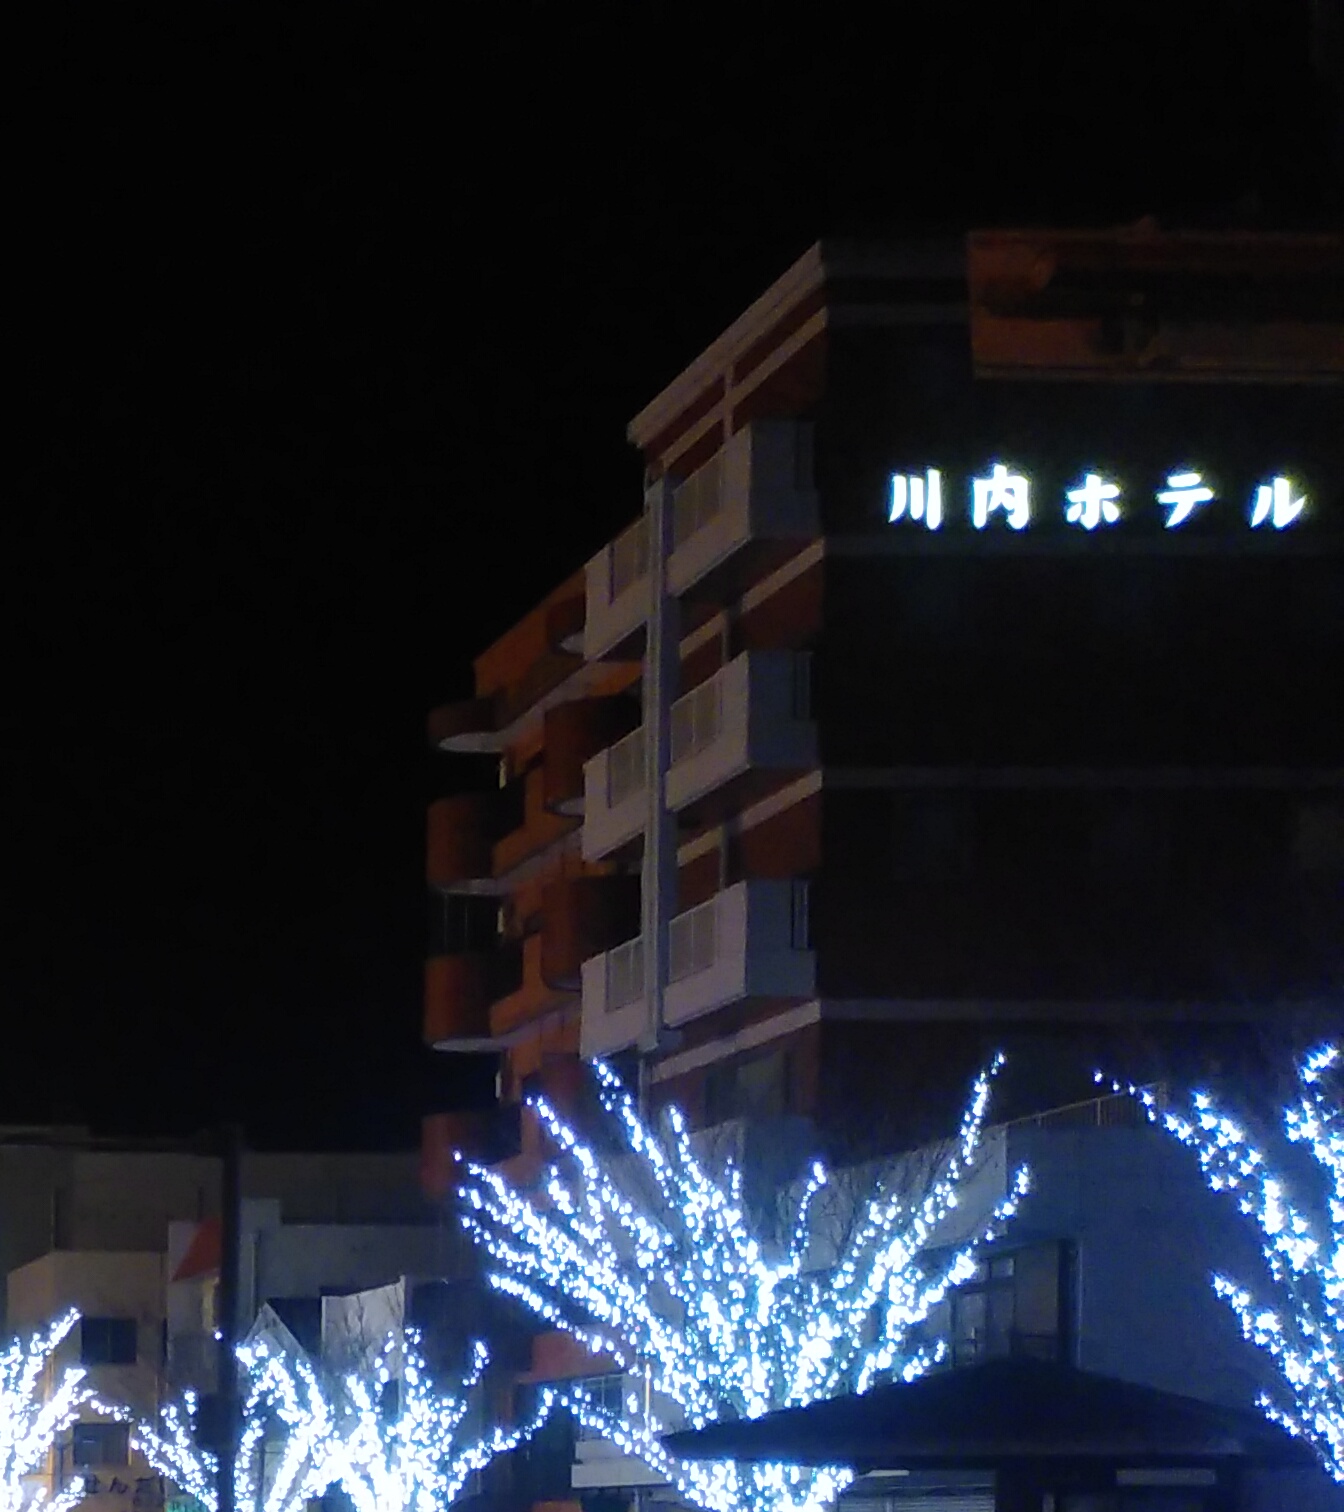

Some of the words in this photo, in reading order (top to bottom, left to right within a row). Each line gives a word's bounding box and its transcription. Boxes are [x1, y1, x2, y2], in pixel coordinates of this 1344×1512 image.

[889, 464, 1306, 530] 川内ホテル
